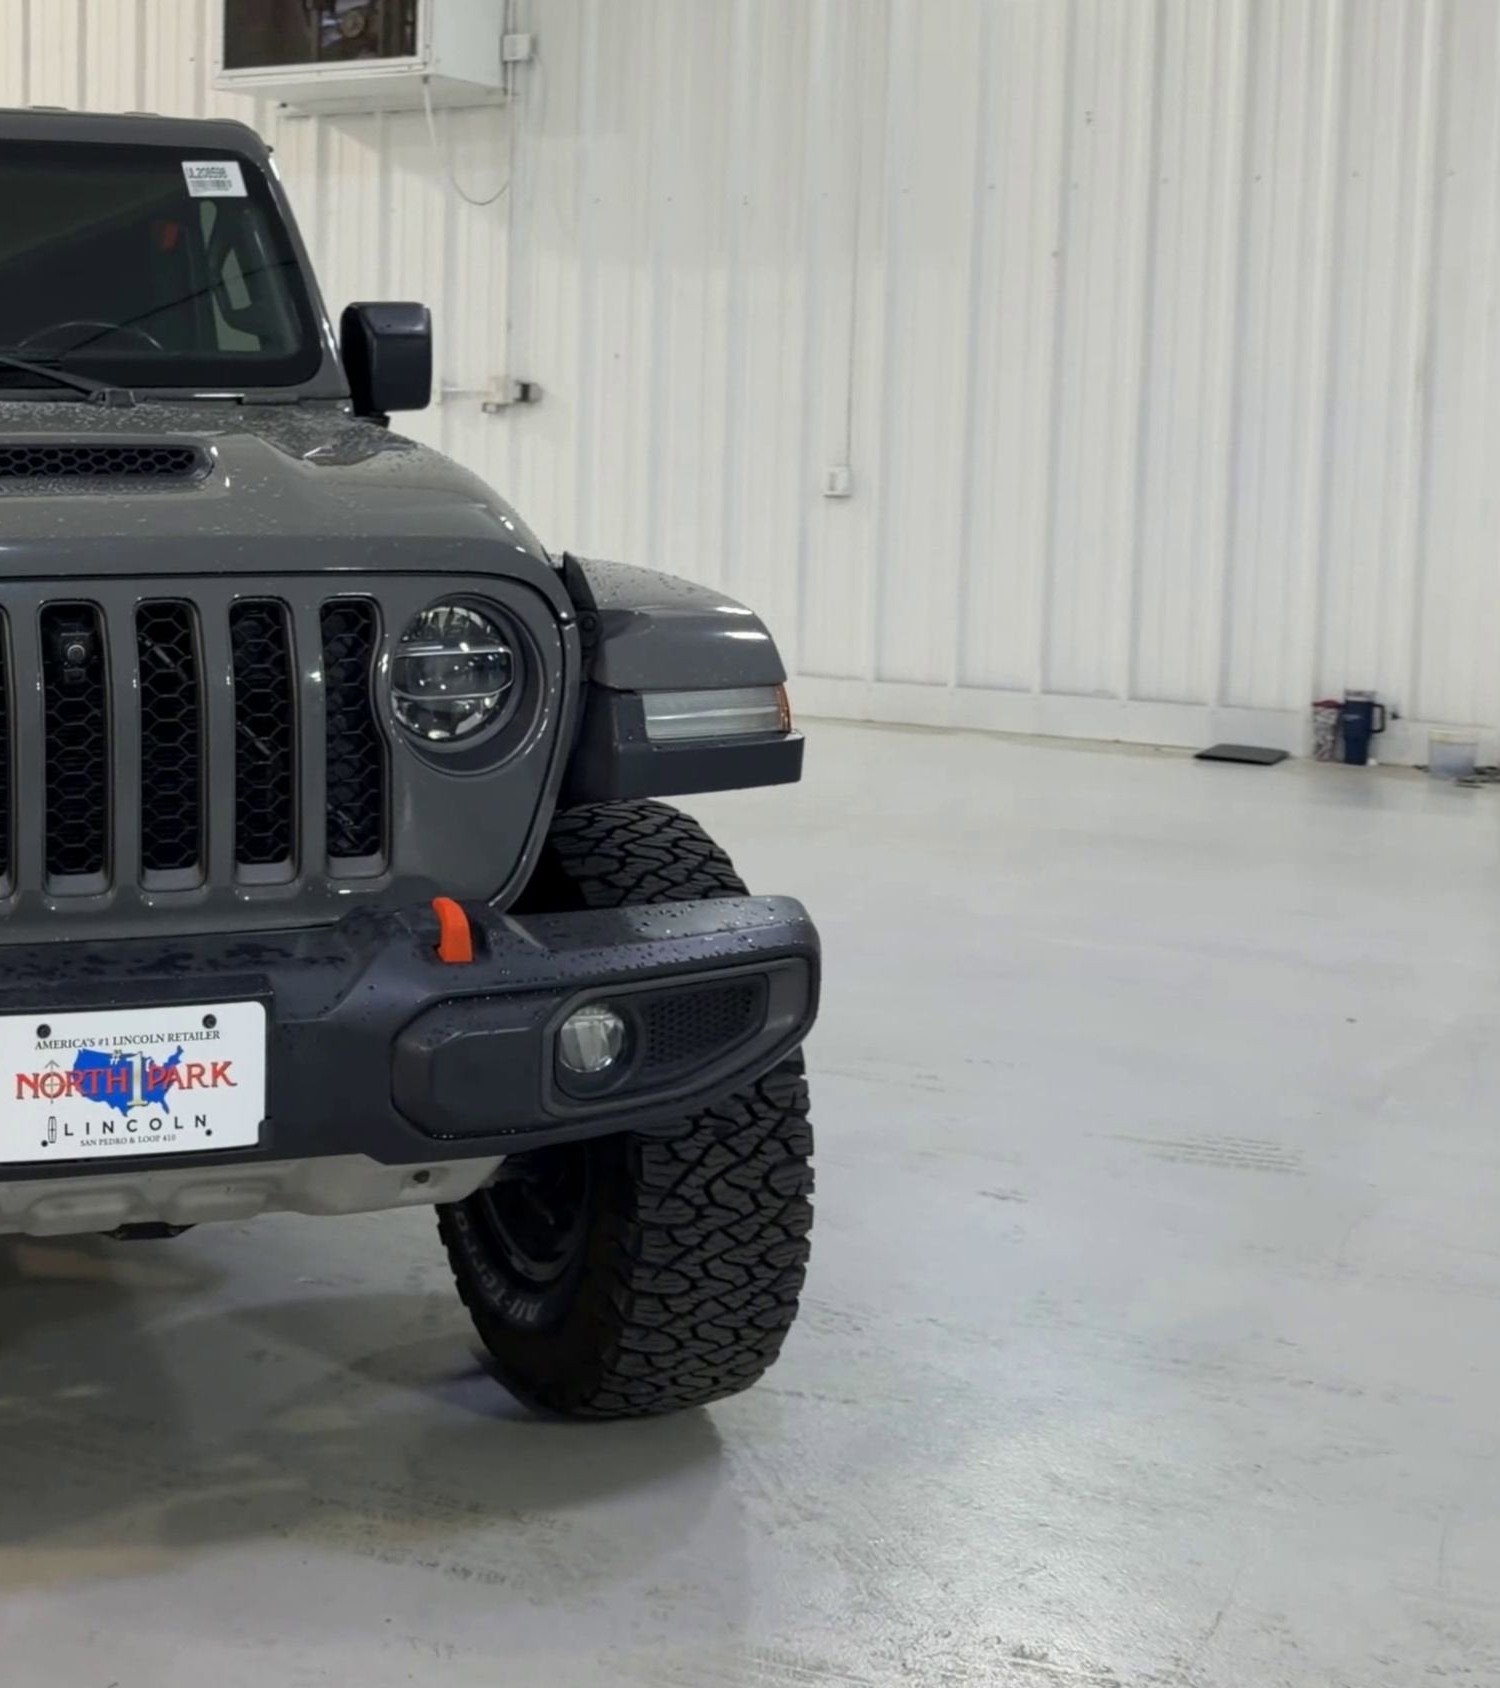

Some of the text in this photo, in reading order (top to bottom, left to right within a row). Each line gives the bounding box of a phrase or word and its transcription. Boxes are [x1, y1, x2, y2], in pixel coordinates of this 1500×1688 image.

[35, 1030, 220, 1050] AMERICA'S #1 LINCOLN RETAILER
[15, 1060, 238, 1100] NORTH PARK
[64, 1114, 207, 1136] LINCOLN
[80, 1134, 177, 1147] SAN PEDRO & LOOP 410
